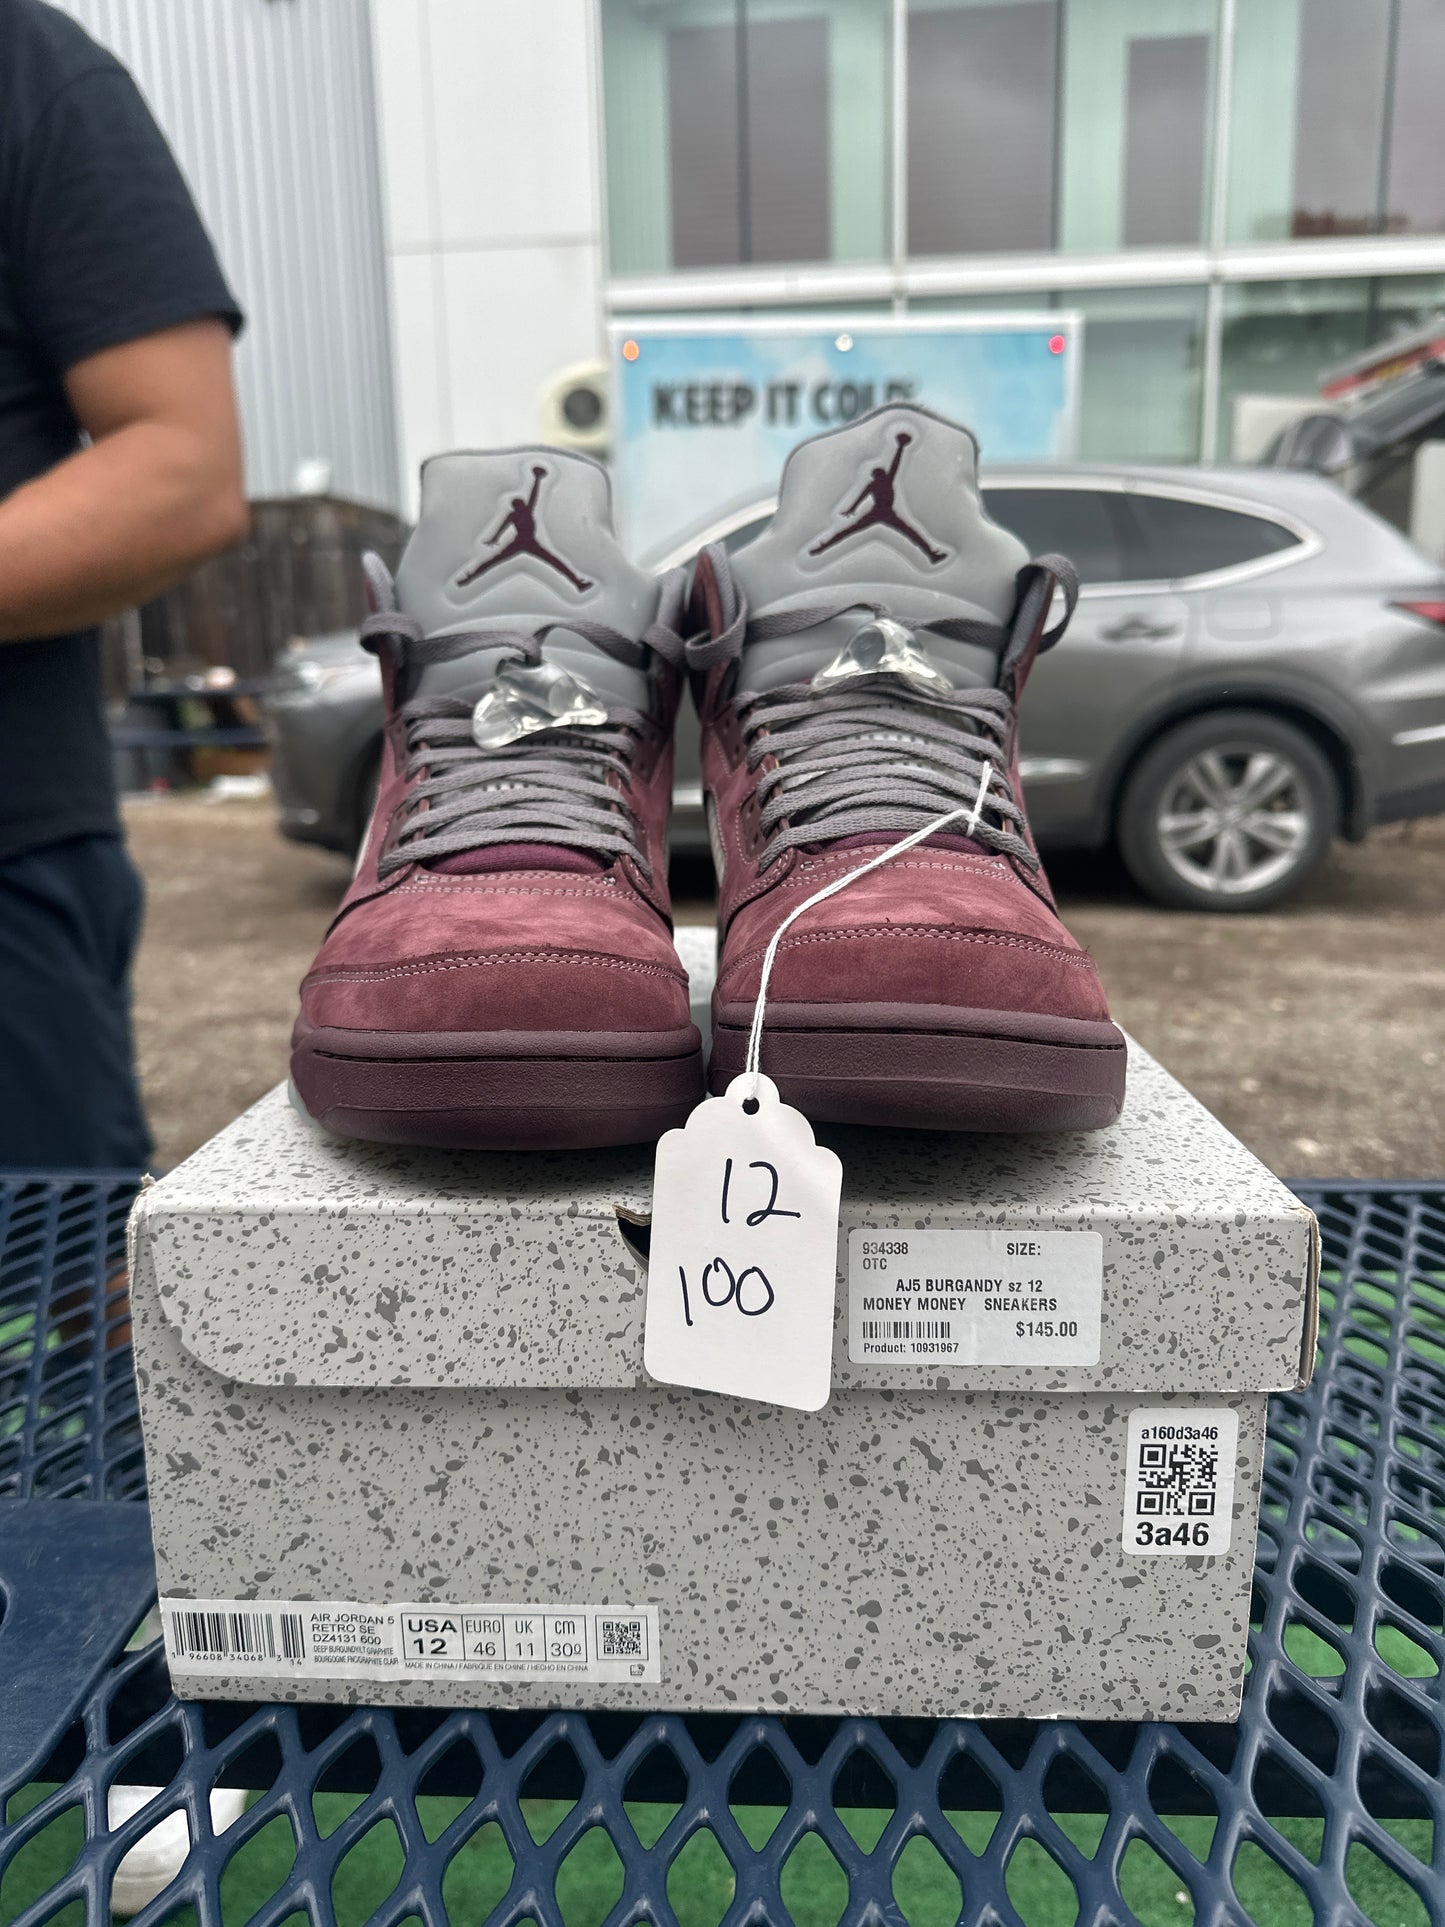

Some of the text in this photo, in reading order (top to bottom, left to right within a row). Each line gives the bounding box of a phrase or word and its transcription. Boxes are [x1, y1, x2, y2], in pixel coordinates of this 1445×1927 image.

[653, 381, 754, 427] KEEP
[764, 381, 800, 428] IT
[721, 1157, 802, 1227] 12
[862, 1241, 1042, 1256] 934338 SIZE:
[862, 1257, 888, 1270] OTC
[678, 1256, 776, 1327] 100
[895, 1278, 1043, 1293] AJ5 BURGANDY sz 12
[863, 1297, 1057, 1311] MONEY MONEY SNEAKERS
[1015, 1320, 1078, 1338] $145.00
[863, 1342, 959, 1354] Product: 10931967
[1141, 1426, 1219, 1441] a160d3a46
[1135, 1521, 1210, 1547] 3a46
[310, 1613, 395, 1625] AIR JORDAN 5
[408, 1619, 458, 1633] USA
[465, 1620, 501, 1634] EURO
[515, 1620, 534, 1634] UK
[312, 1623, 376, 1635] RETRO SE
[312, 1633, 382, 1645] DZ4131 600
[313, 1645, 328, 1653] DEEP
[413, 1638, 448, 1655] 12
[473, 1641, 497, 1657] 46
[515, 1642, 535, 1657] 11
[189, 1653, 223, 1661] 96608
[230, 1654, 264, 1662] 34068
[405, 1661, 424, 1669] MADE
[434, 1662, 454, 1670] CHINA
[460, 1663, 493, 1671] FABRIQUE
[494, 1663, 503, 1671] EN
[505, 1663, 526, 1671] CHINE
[531, 1664, 555, 1672] HECHO
[556, 1664, 566, 1672] EN
[567, 1664, 589, 1672] CHINA
